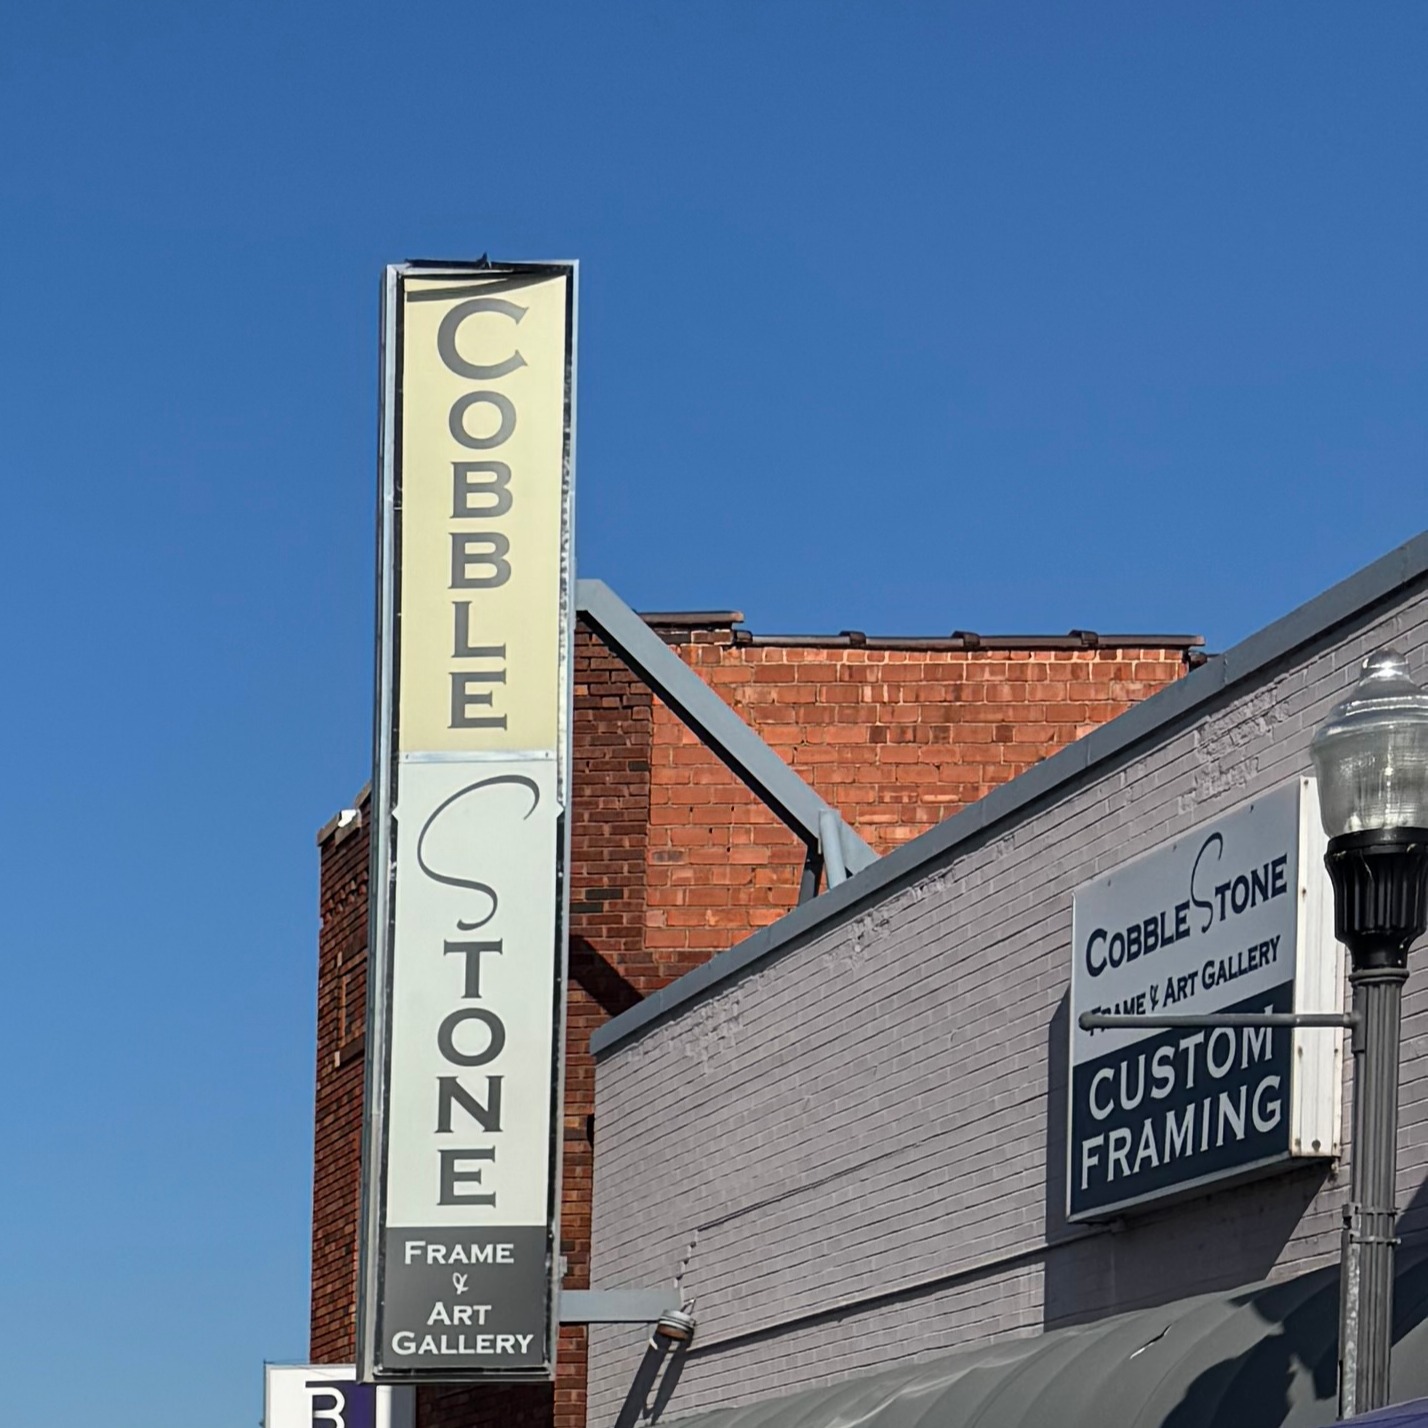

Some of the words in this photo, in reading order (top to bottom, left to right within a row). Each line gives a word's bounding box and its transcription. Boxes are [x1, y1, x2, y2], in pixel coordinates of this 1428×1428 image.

[1162, 970, 1199, 1003] ART
[1202, 934, 1281, 990] GALLERY
[1088, 1004, 1274, 1120] CUSTOM
[1081, 1075, 1281, 1190] FRAMING
[403, 1240, 515, 1265] FRAME
[451, 1272, 469, 1295] &
[425, 1302, 492, 1326] ART
[391, 1331, 534, 1356] GALLERY
